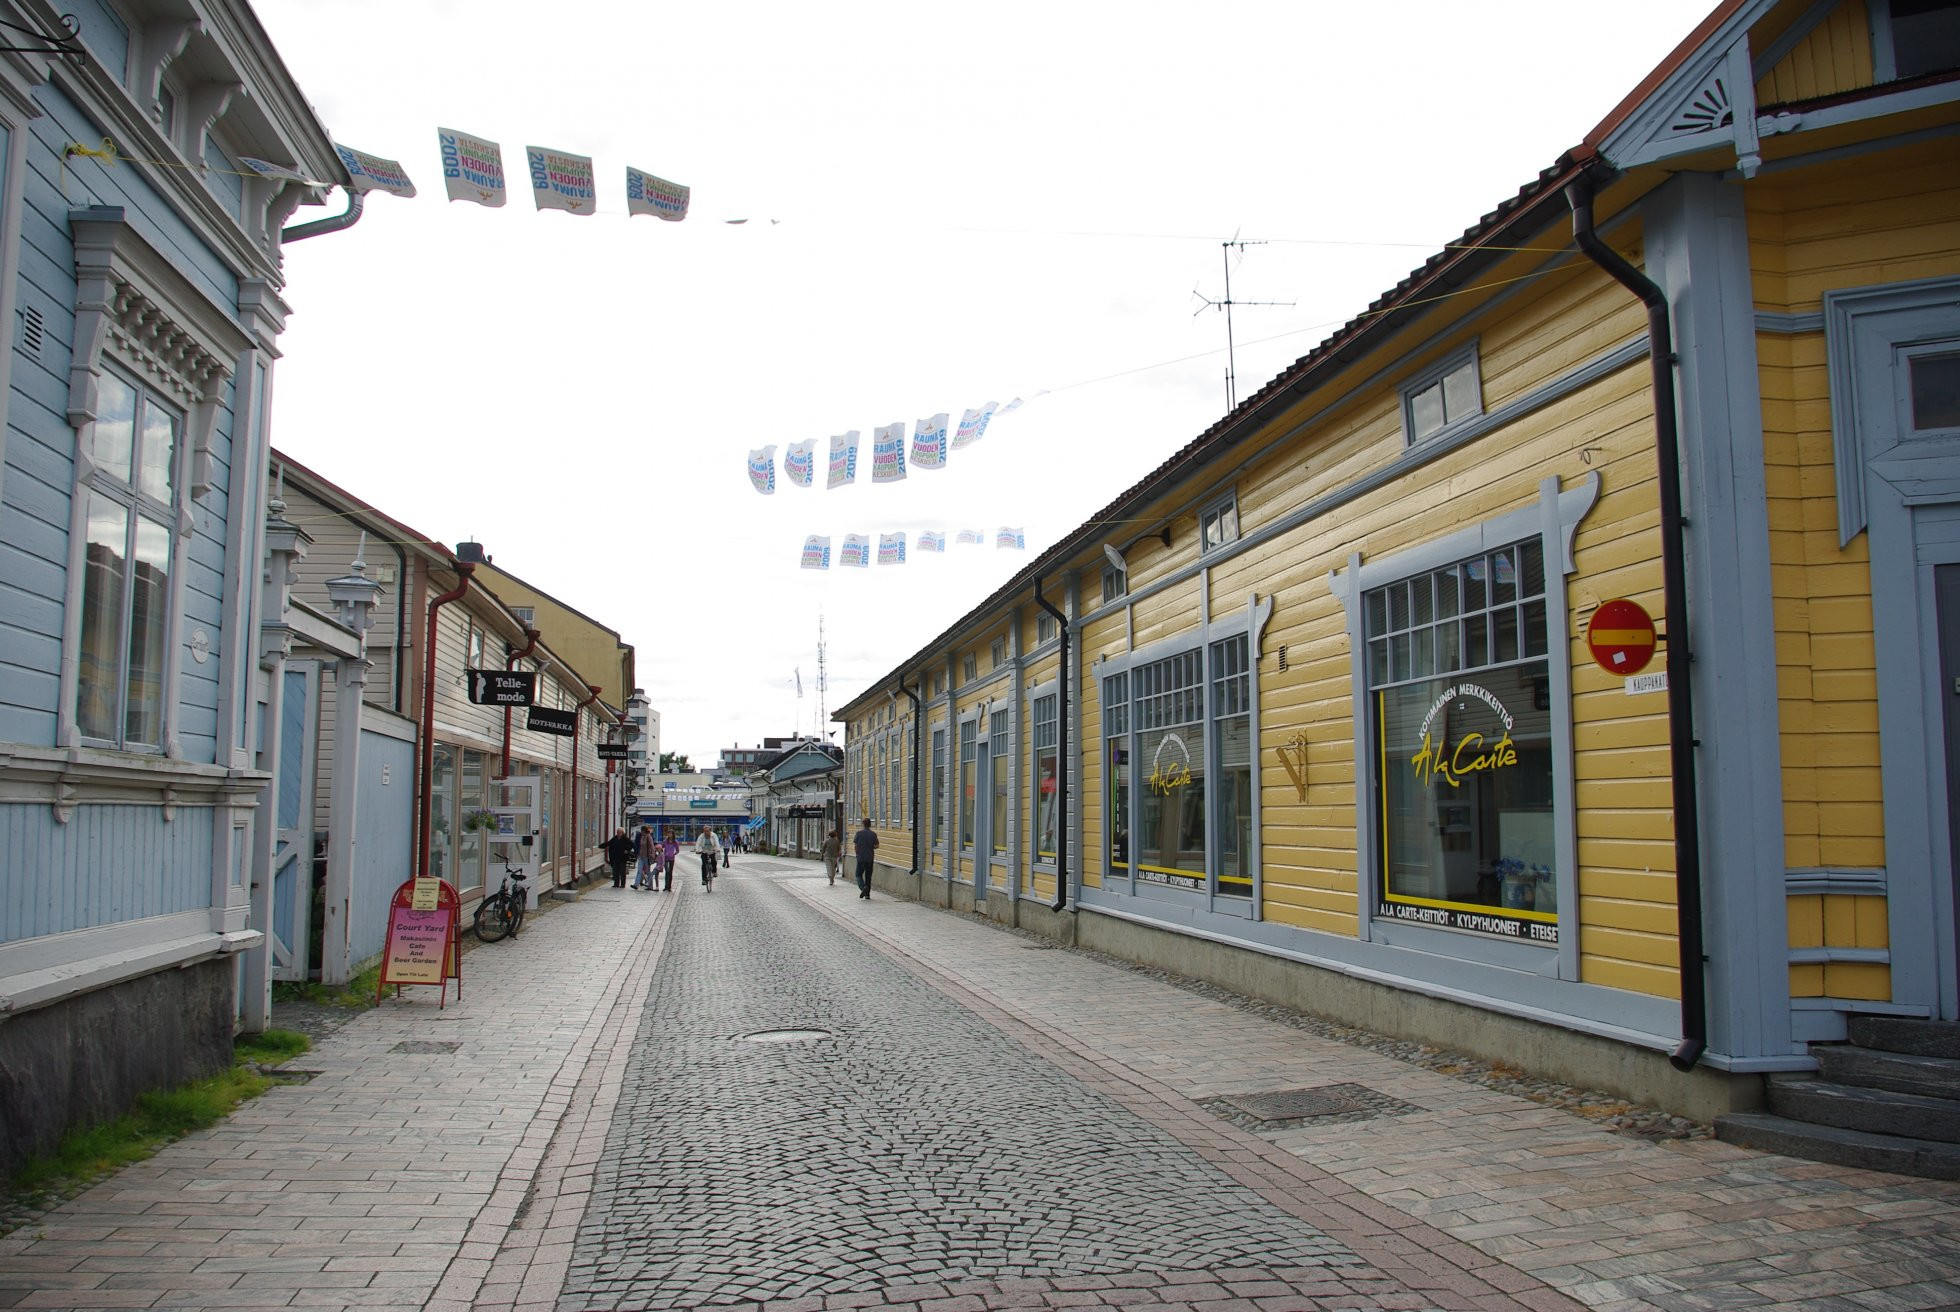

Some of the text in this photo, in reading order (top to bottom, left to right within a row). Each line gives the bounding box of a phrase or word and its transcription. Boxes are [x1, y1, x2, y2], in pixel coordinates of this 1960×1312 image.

[441, 135, 461, 178] 2009
[458, 137, 500, 156] KESKUSTA
[338, 148, 364, 176] 2009
[461, 156, 503, 176] VUODEN
[528, 152, 549, 189] 2009
[548, 155, 592, 169] KESKUSTA
[463, 169, 504, 189] RAUMA
[550, 172, 592, 187] VUODEN
[628, 171, 644, 200] 2009
[552, 183, 593, 198] RAUMA
[847, 446, 857, 479] 2009
[874, 453, 897, 464] VUODEN
[896, 439, 906, 474] 2009
[805, 452, 813, 483] 2009
[822, 547, 830, 567] 2009
[861, 546, 869, 565] 2009
[496, 677, 526, 688] Telle-
[497, 692, 525, 702] mode
[1419, 683, 1514, 741] KOTIMAINEN MERKKIKEITTIÖ
[530, 718, 573, 731] KOTI-VAKKA
[1453, 731, 1518, 775] Carte
[1397, 906, 1449, 925] CARTE-KEITTIÖT
[1457, 914, 1521, 936] KYLPYHUONEET
